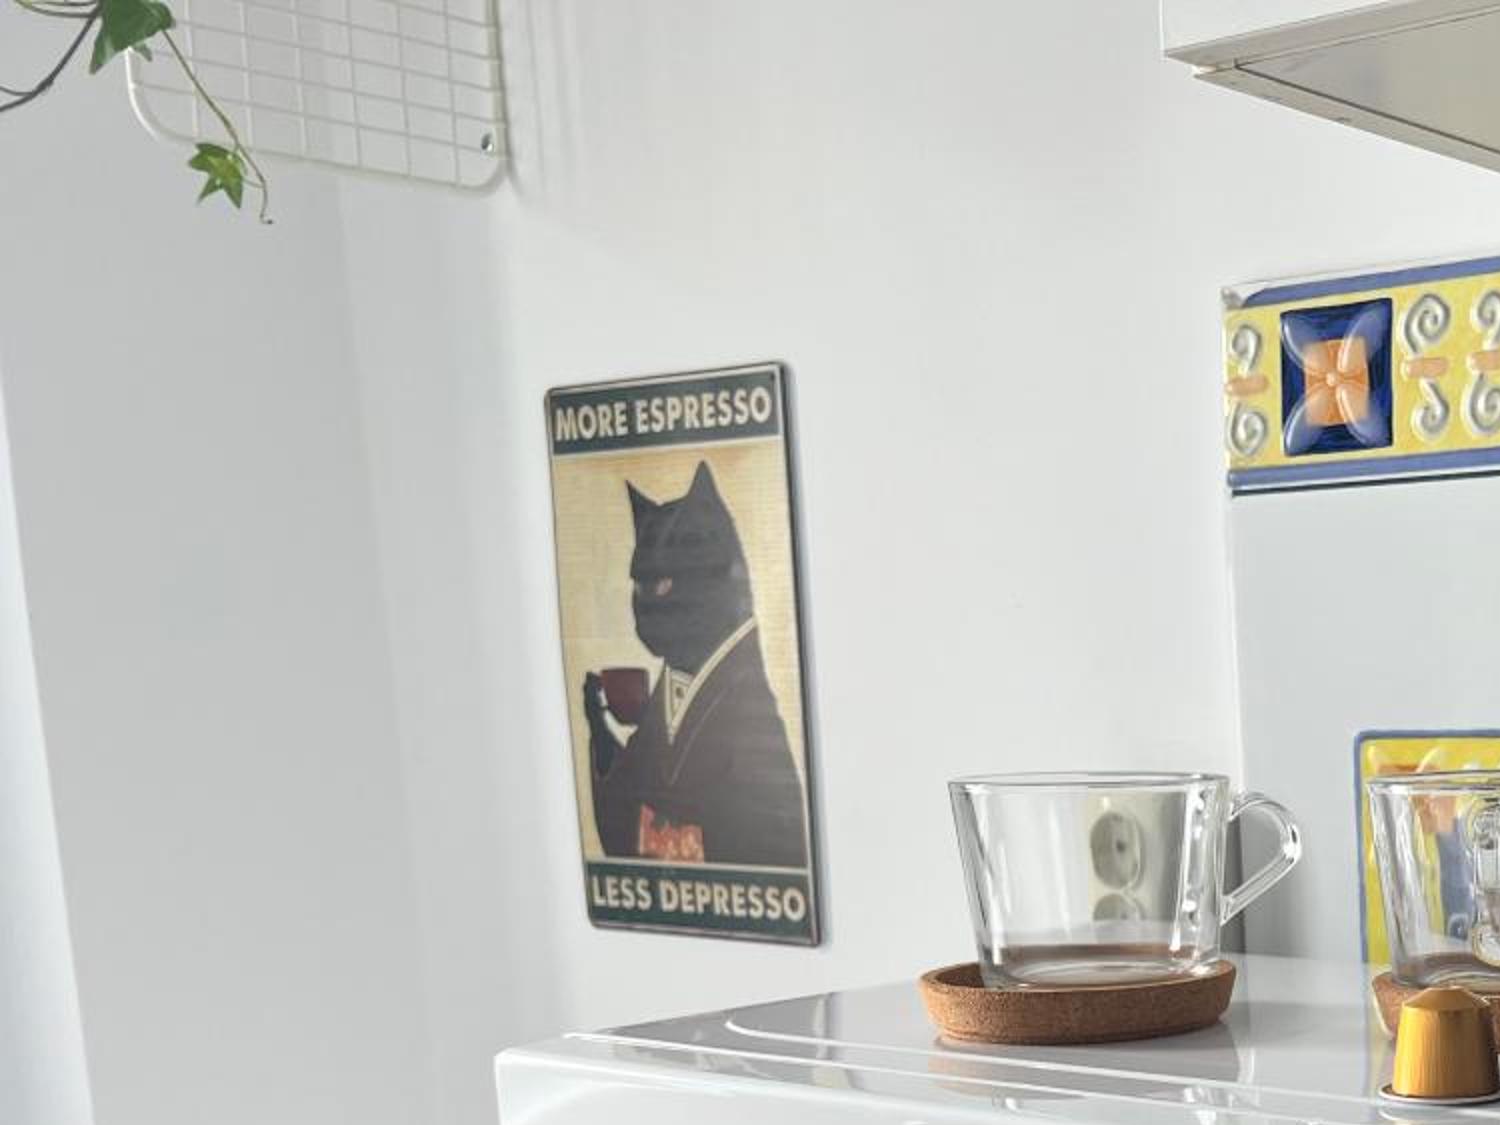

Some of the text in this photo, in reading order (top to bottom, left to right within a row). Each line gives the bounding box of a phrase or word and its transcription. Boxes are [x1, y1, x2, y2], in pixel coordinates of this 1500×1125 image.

[555, 386, 772, 441] MORE ESPRESSO
[592, 875, 806, 922] LESS DEPRESSO
